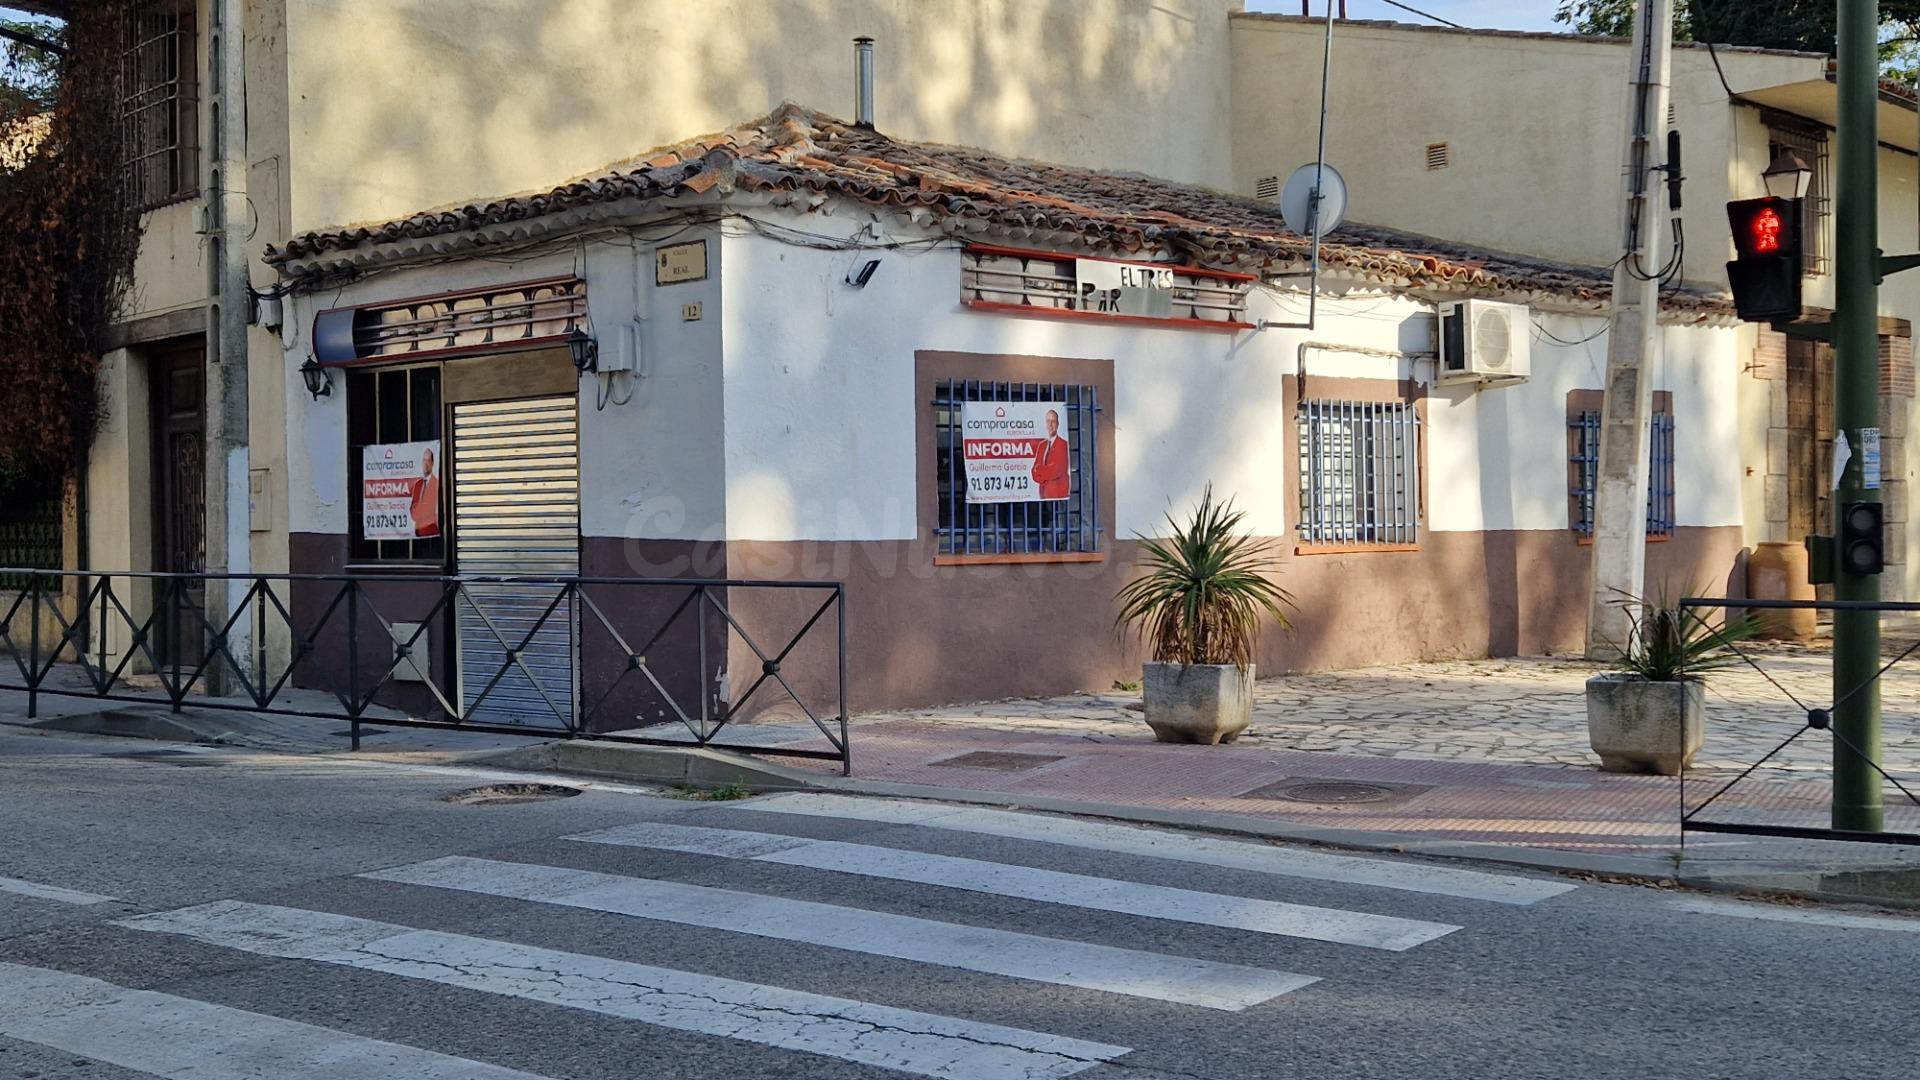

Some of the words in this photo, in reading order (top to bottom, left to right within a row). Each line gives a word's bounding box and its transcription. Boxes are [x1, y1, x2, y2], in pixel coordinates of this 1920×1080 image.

[673, 266, 688, 275] REAL
[1120, 266, 1137, 288] EL
[1137, 268, 1173, 290] TRES
[688, 305, 697, 317] 12
[967, 419, 1034, 432] comprarcasa
[967, 442, 1034, 457] INFORMA
[969, 462, 1002, 472] Guillermo
[366, 482, 410, 496] INFORMA
[971, 478, 982, 491] 91
[984, 477, 1002, 491] 873
